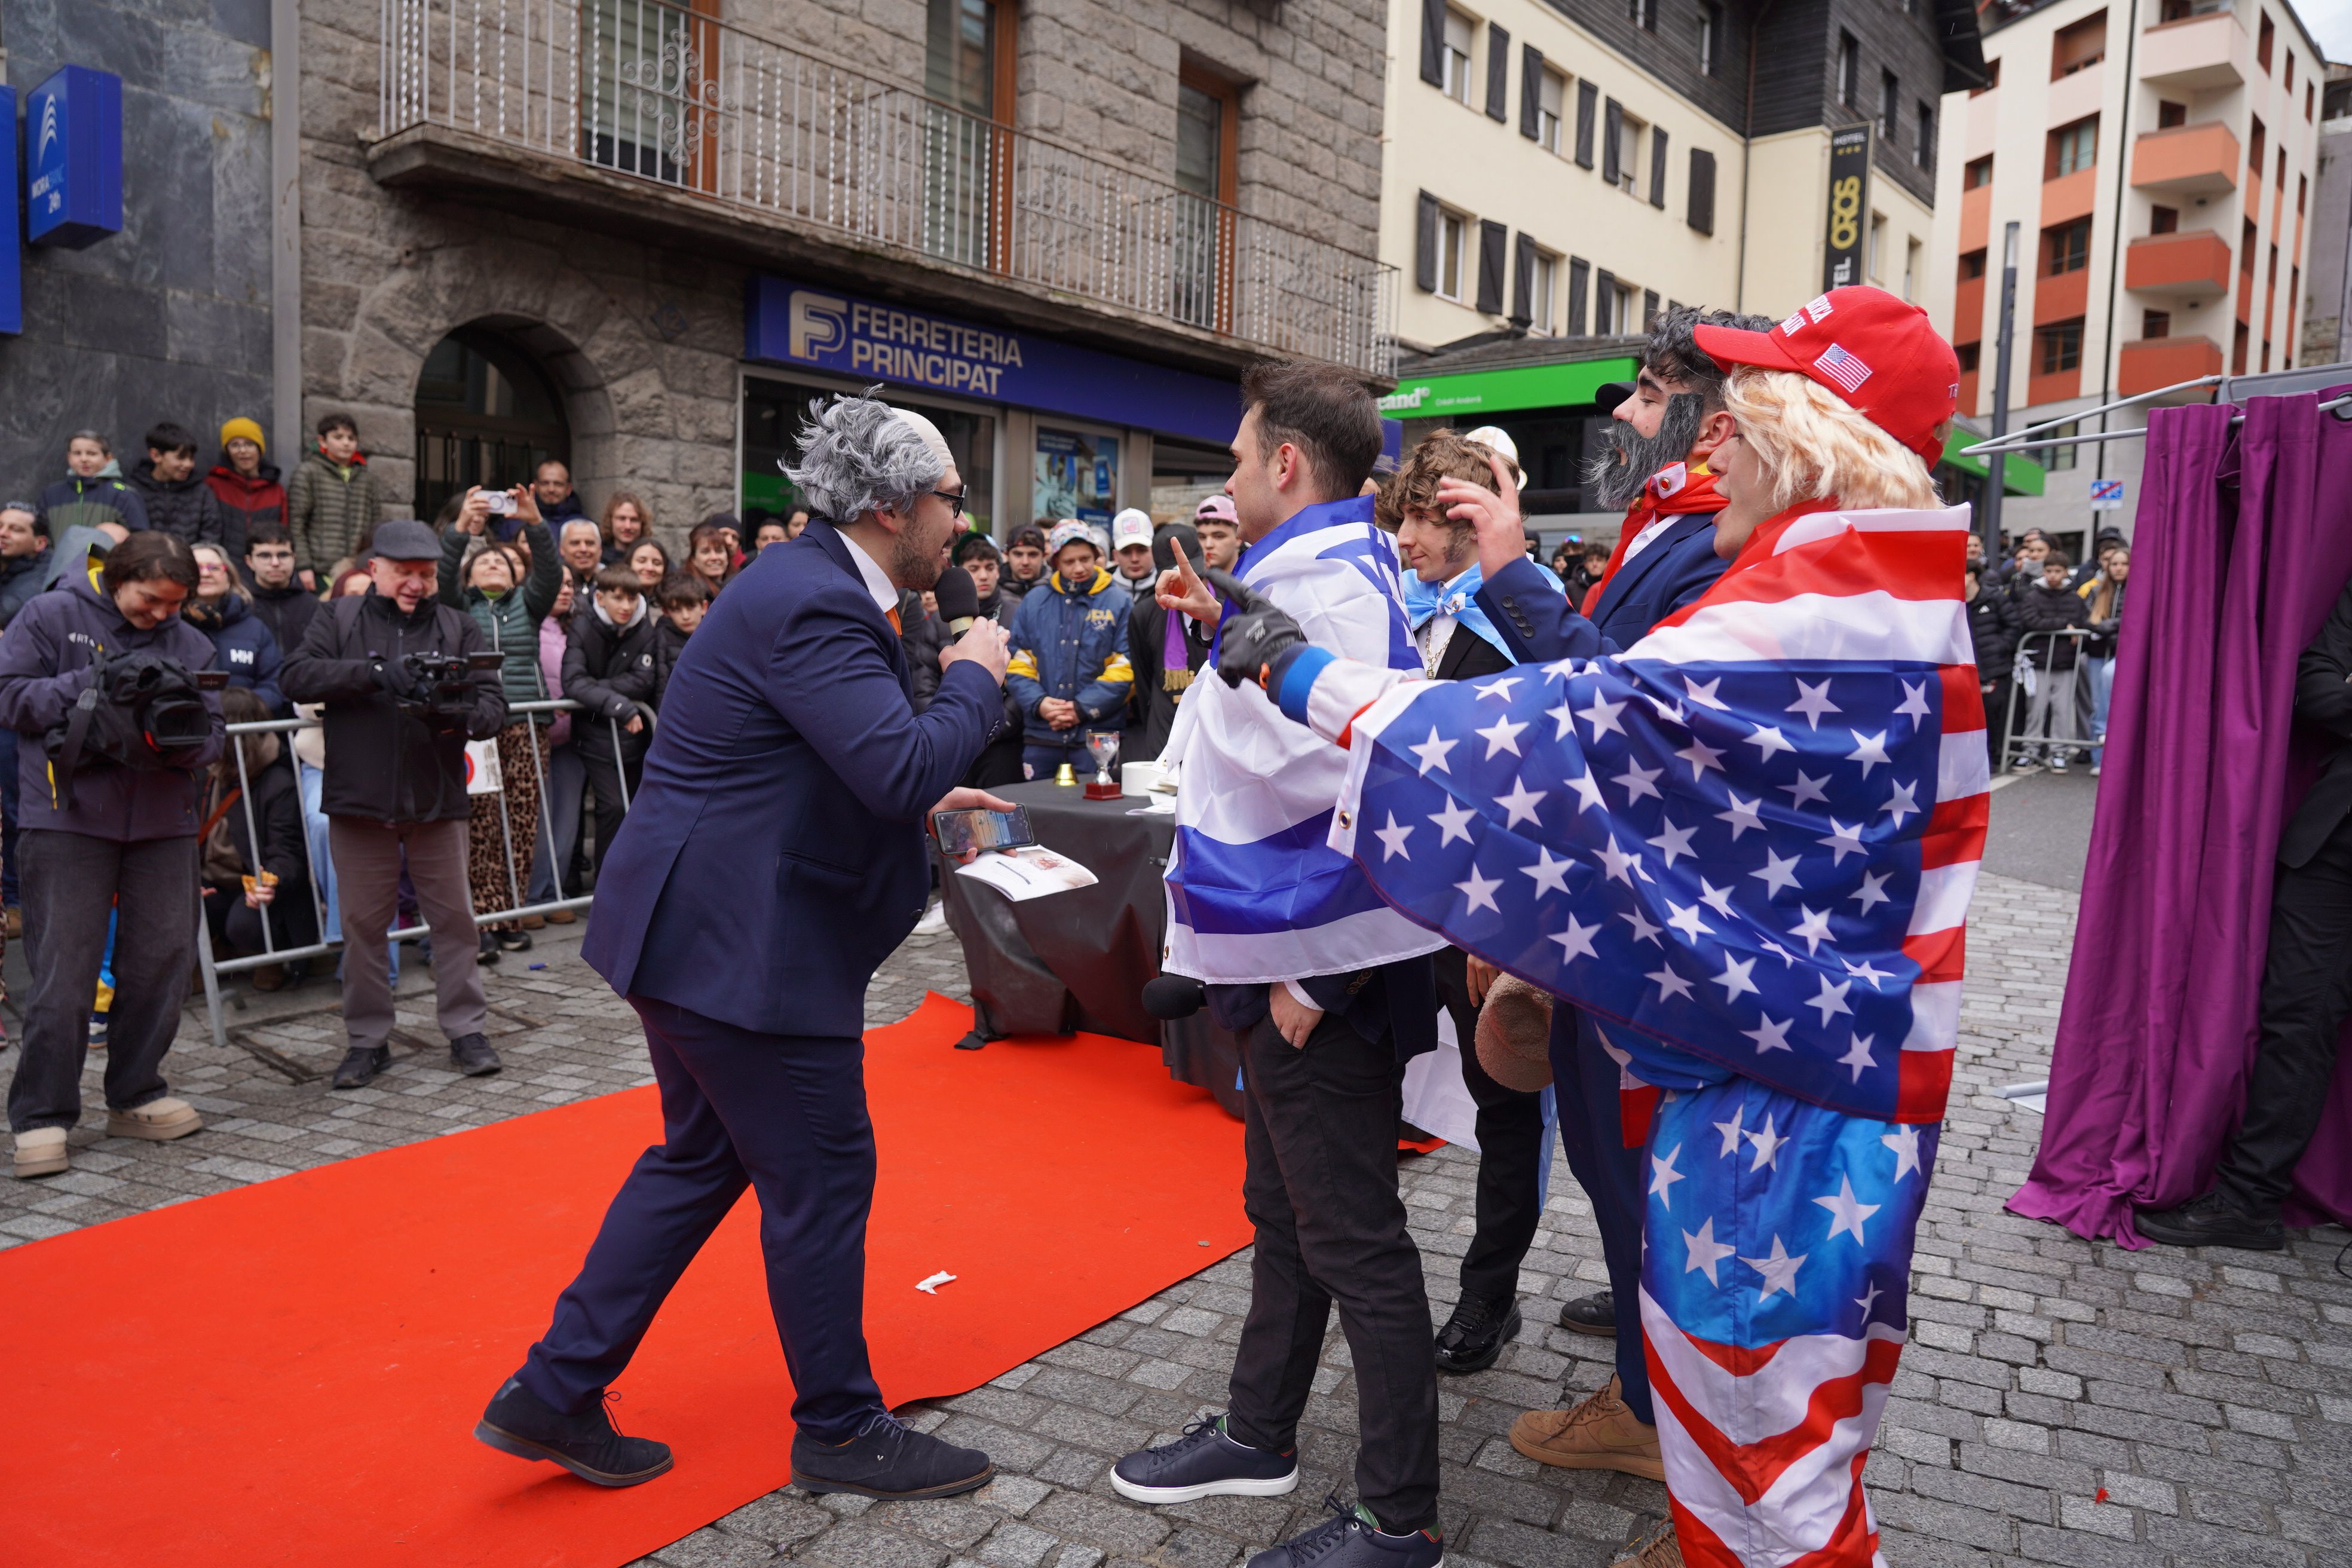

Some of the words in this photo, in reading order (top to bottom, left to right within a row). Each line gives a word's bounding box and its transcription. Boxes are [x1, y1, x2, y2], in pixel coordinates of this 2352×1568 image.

[1833, 132, 1867, 146] HOTEL
[1830, 175, 1861, 250] OROS
[853, 303, 1022, 368] FERRETERIA
[852, 339, 1003, 395] PRINCIPAT
